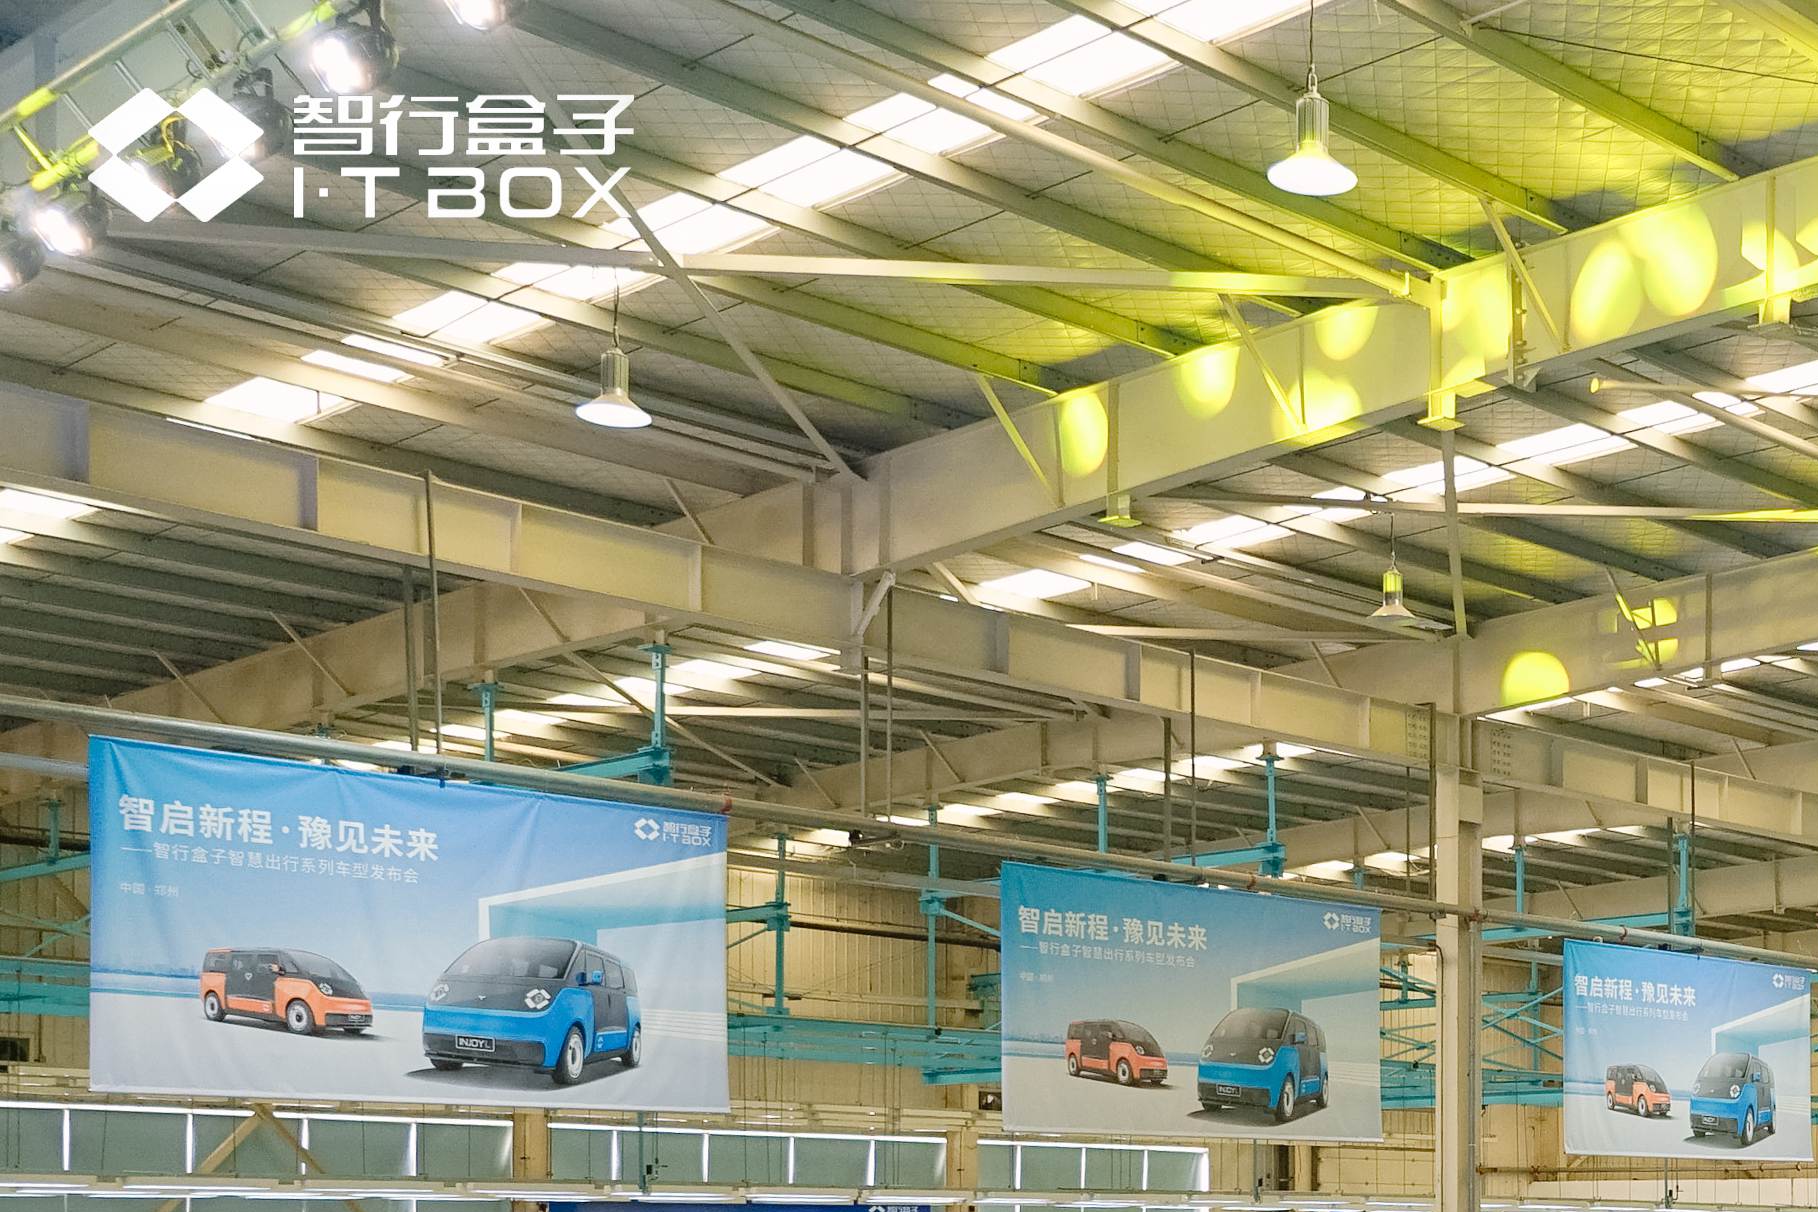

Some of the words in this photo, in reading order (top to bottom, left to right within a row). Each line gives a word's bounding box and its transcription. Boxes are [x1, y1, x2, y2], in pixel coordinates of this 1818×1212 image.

[119, 794, 439, 862] 智启新程·豫见未来
[1018, 905, 1208, 951] 智启新程·豫见未来
[1574, 975, 1697, 1008] 智启新程·豫见未来
